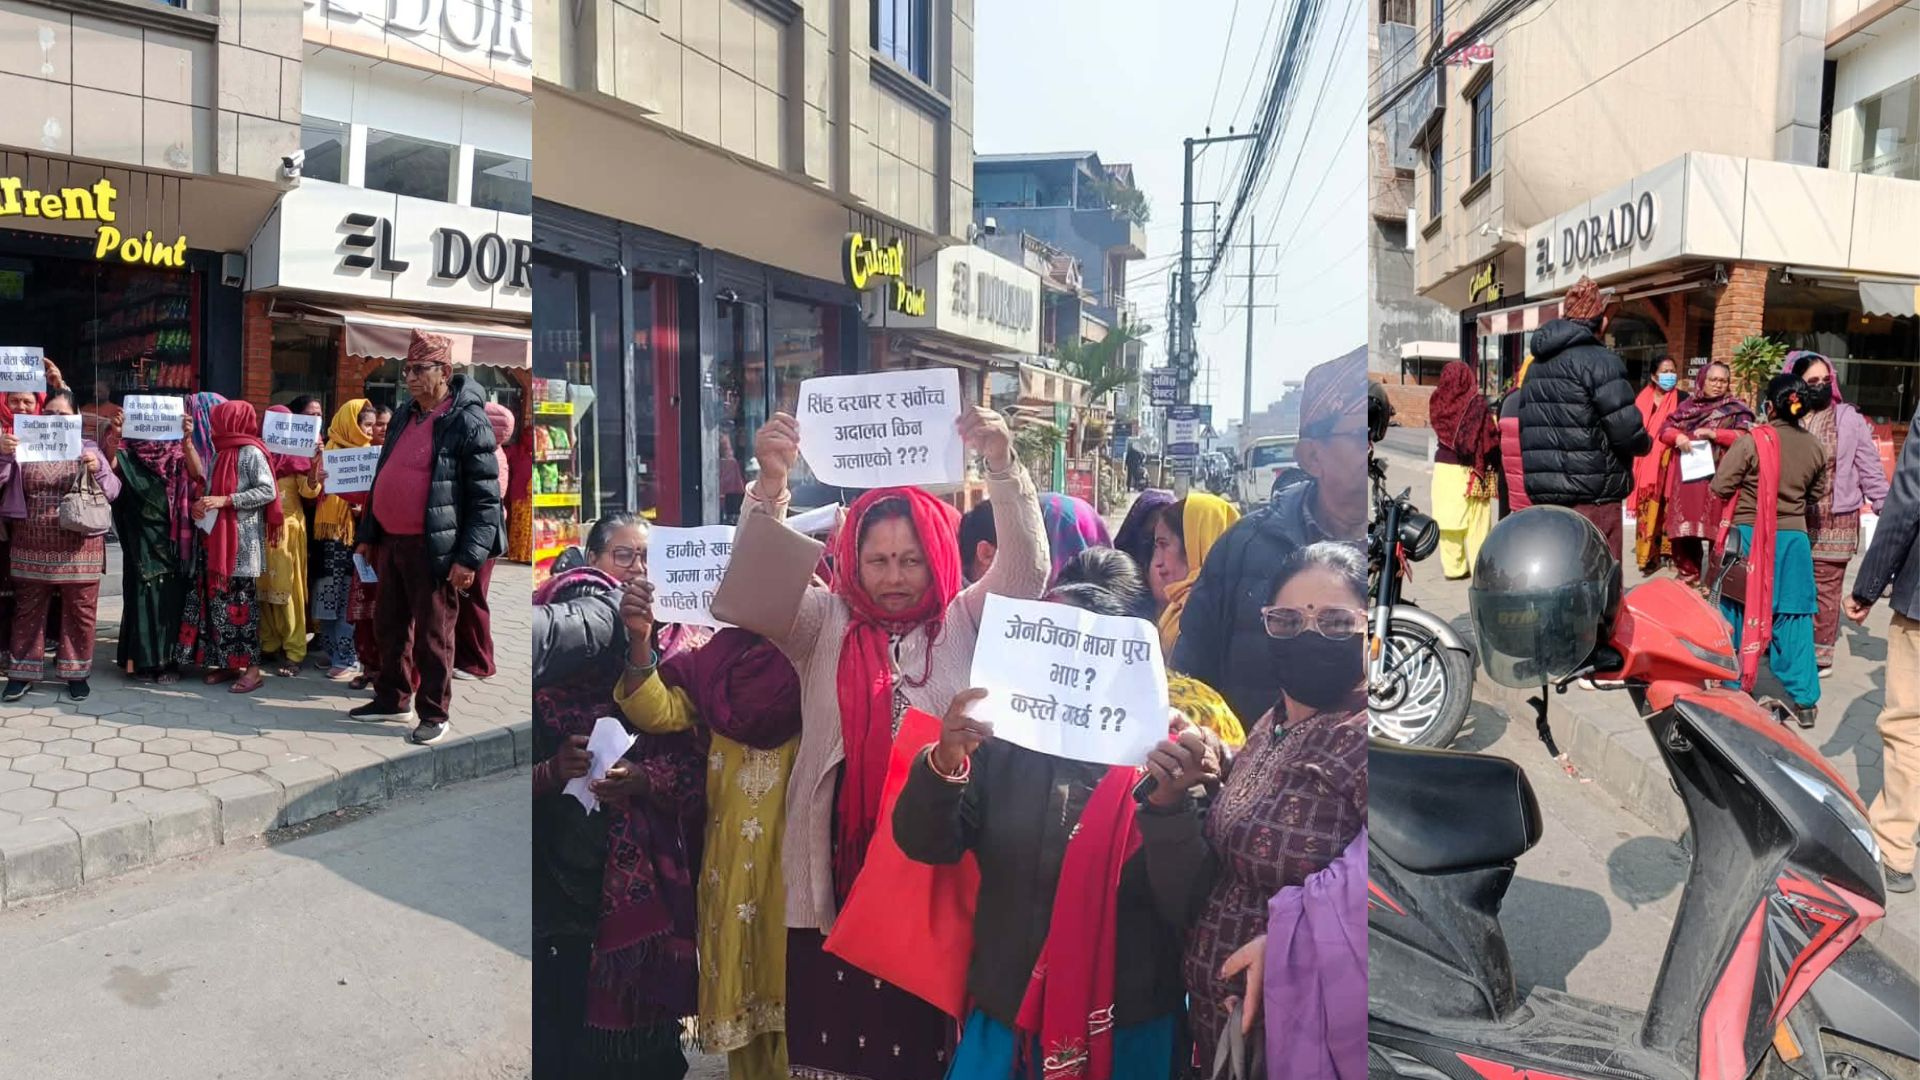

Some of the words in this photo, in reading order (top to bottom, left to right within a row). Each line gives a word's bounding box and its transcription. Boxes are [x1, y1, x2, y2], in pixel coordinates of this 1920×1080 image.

[0, 176, 118, 222] rrent
[95, 225, 188, 267] Point
[342, 212, 410, 273] EL
[1536, 237, 1555, 276] EL
[1562, 191, 1654, 268] DORADO
[897, 281, 926, 317] Point
[808, 393, 834, 414] सिंह
[838, 393, 882, 411] दरबार
[886, 393, 896, 409] र
[834, 422, 887, 441] अदालत
[891, 416, 923, 438] किन
[832, 447, 892, 469] जलाएको
[896, 445, 929, 466] ???
[666, 539, 706, 559] हामीले
[665, 569, 700, 583] जम्मा
[704, 564, 727, 581] गरे
[658, 591, 698, 610] कहिले
[1004, 614, 1082, 650] जेनजिका
[1083, 634, 1118, 657] माग
[1122, 638, 1152, 665] पुरा
[1050, 663, 1080, 688] भाए
[1084, 667, 1097, 691] ?
[1010, 693, 1060, 721] कस्ले
[1099, 706, 1127, 732] ??
